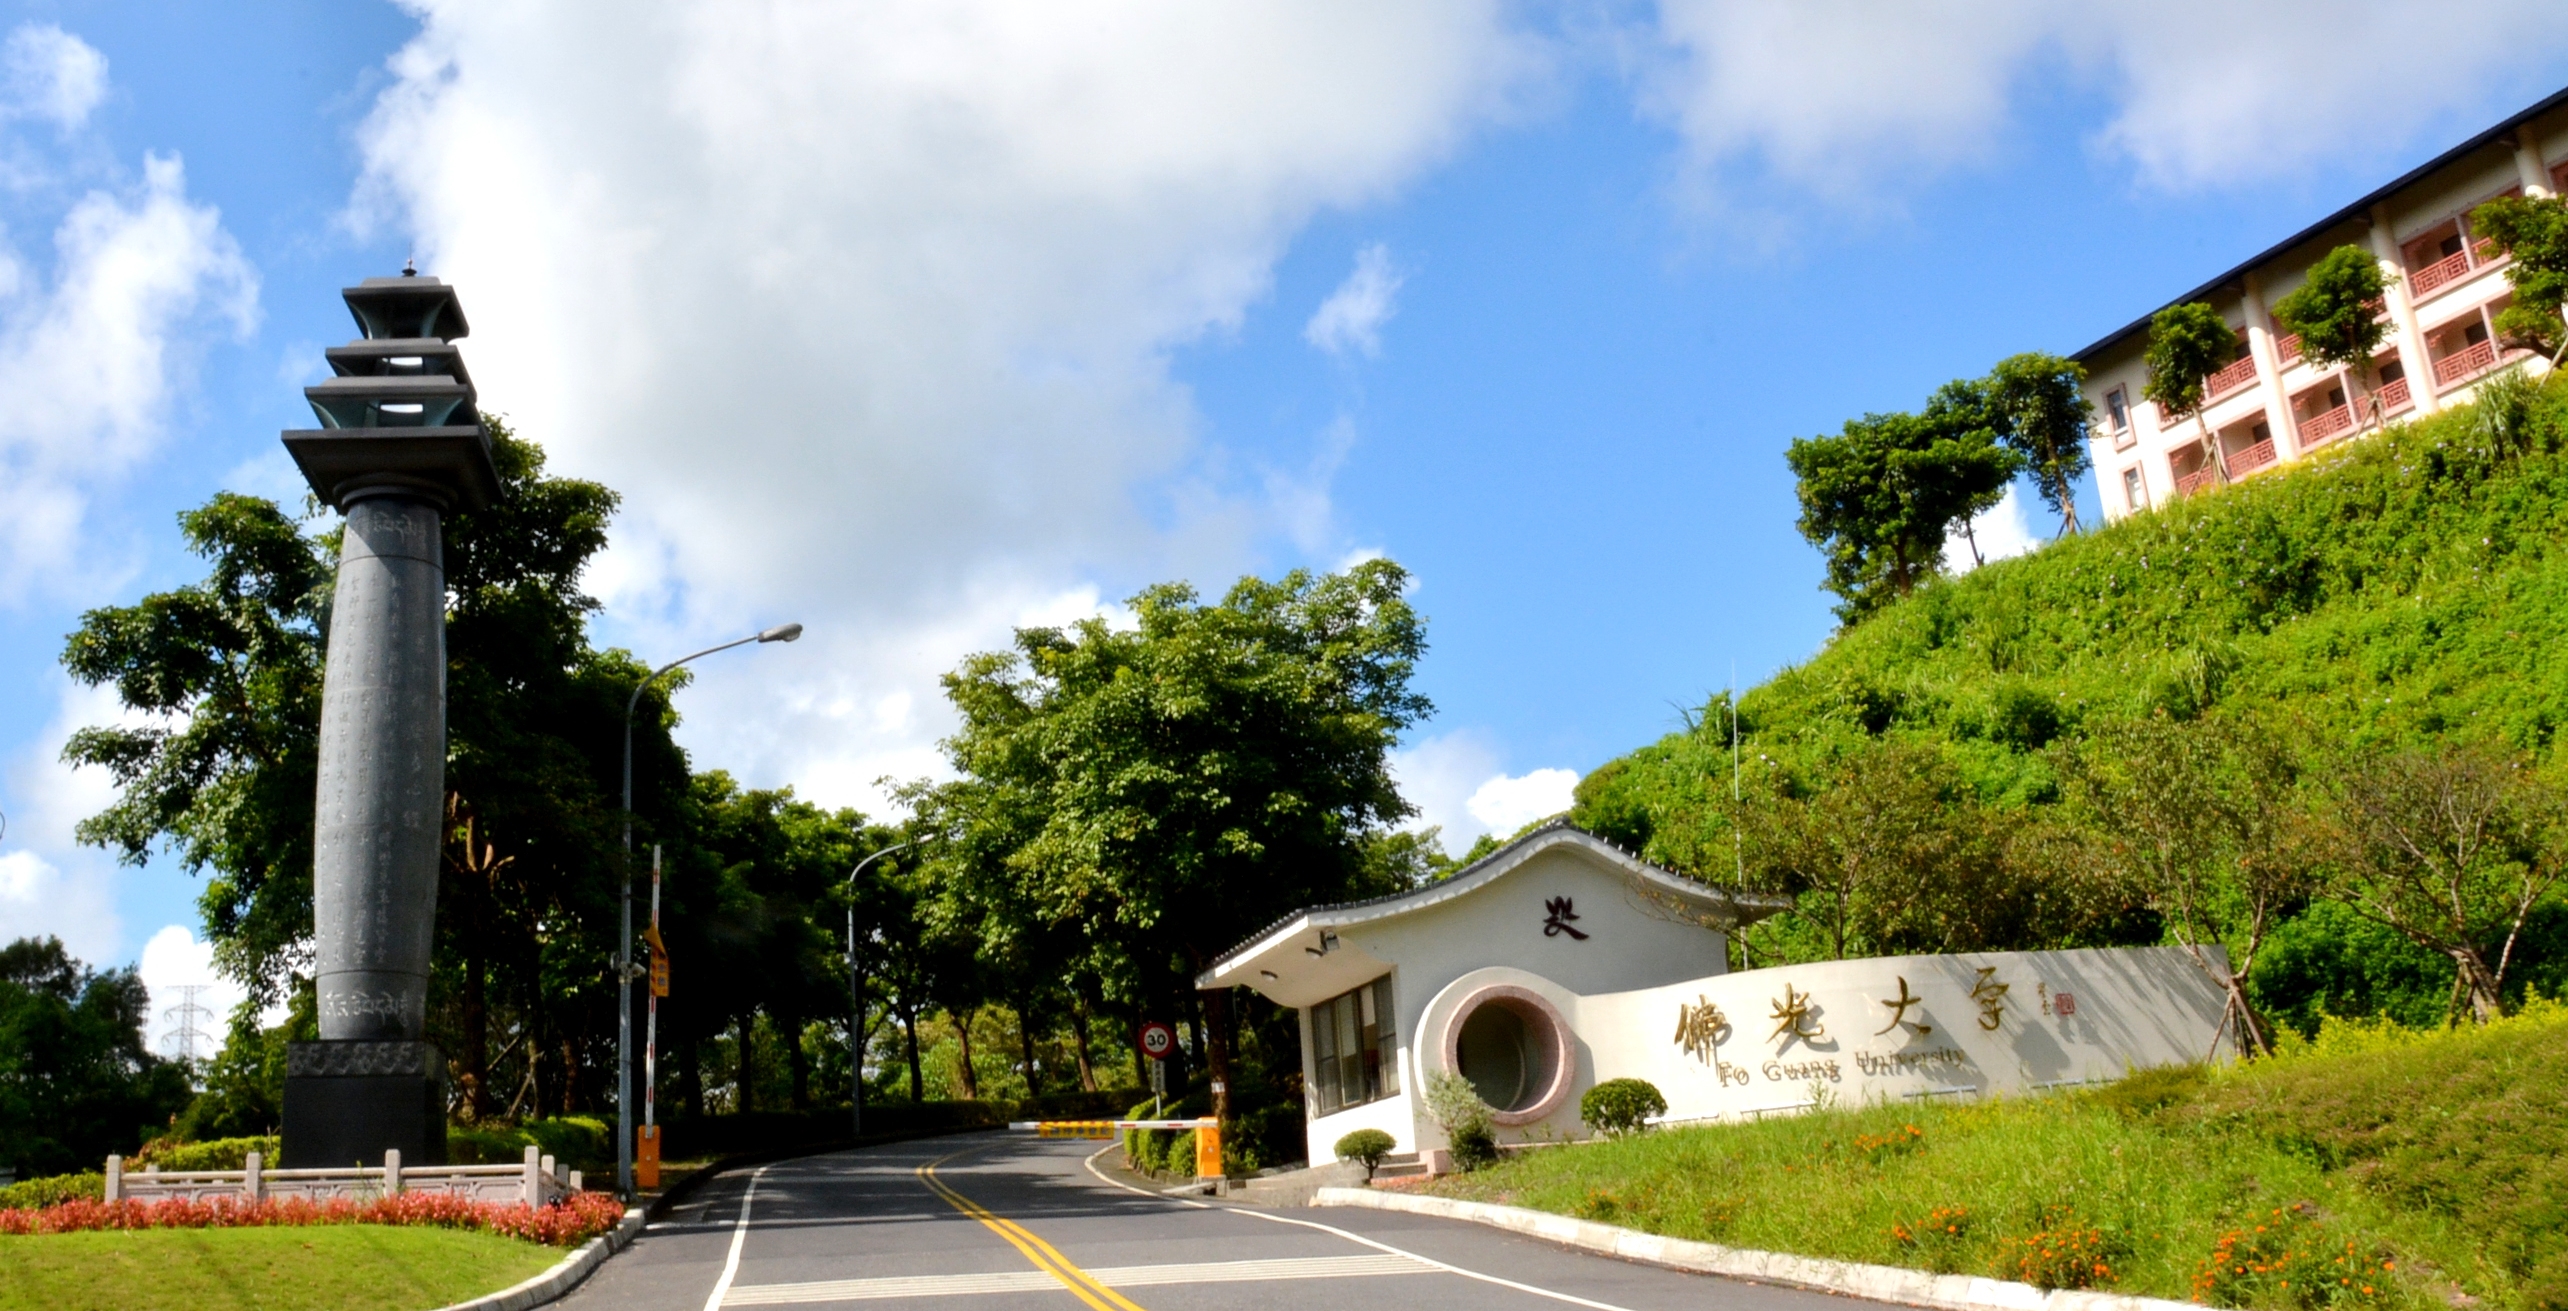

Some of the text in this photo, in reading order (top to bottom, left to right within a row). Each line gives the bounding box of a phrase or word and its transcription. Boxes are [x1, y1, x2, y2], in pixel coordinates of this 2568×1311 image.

[1146, 1034, 1166, 1046] 30
[1718, 1046, 1965, 1085] Fo Guang University
